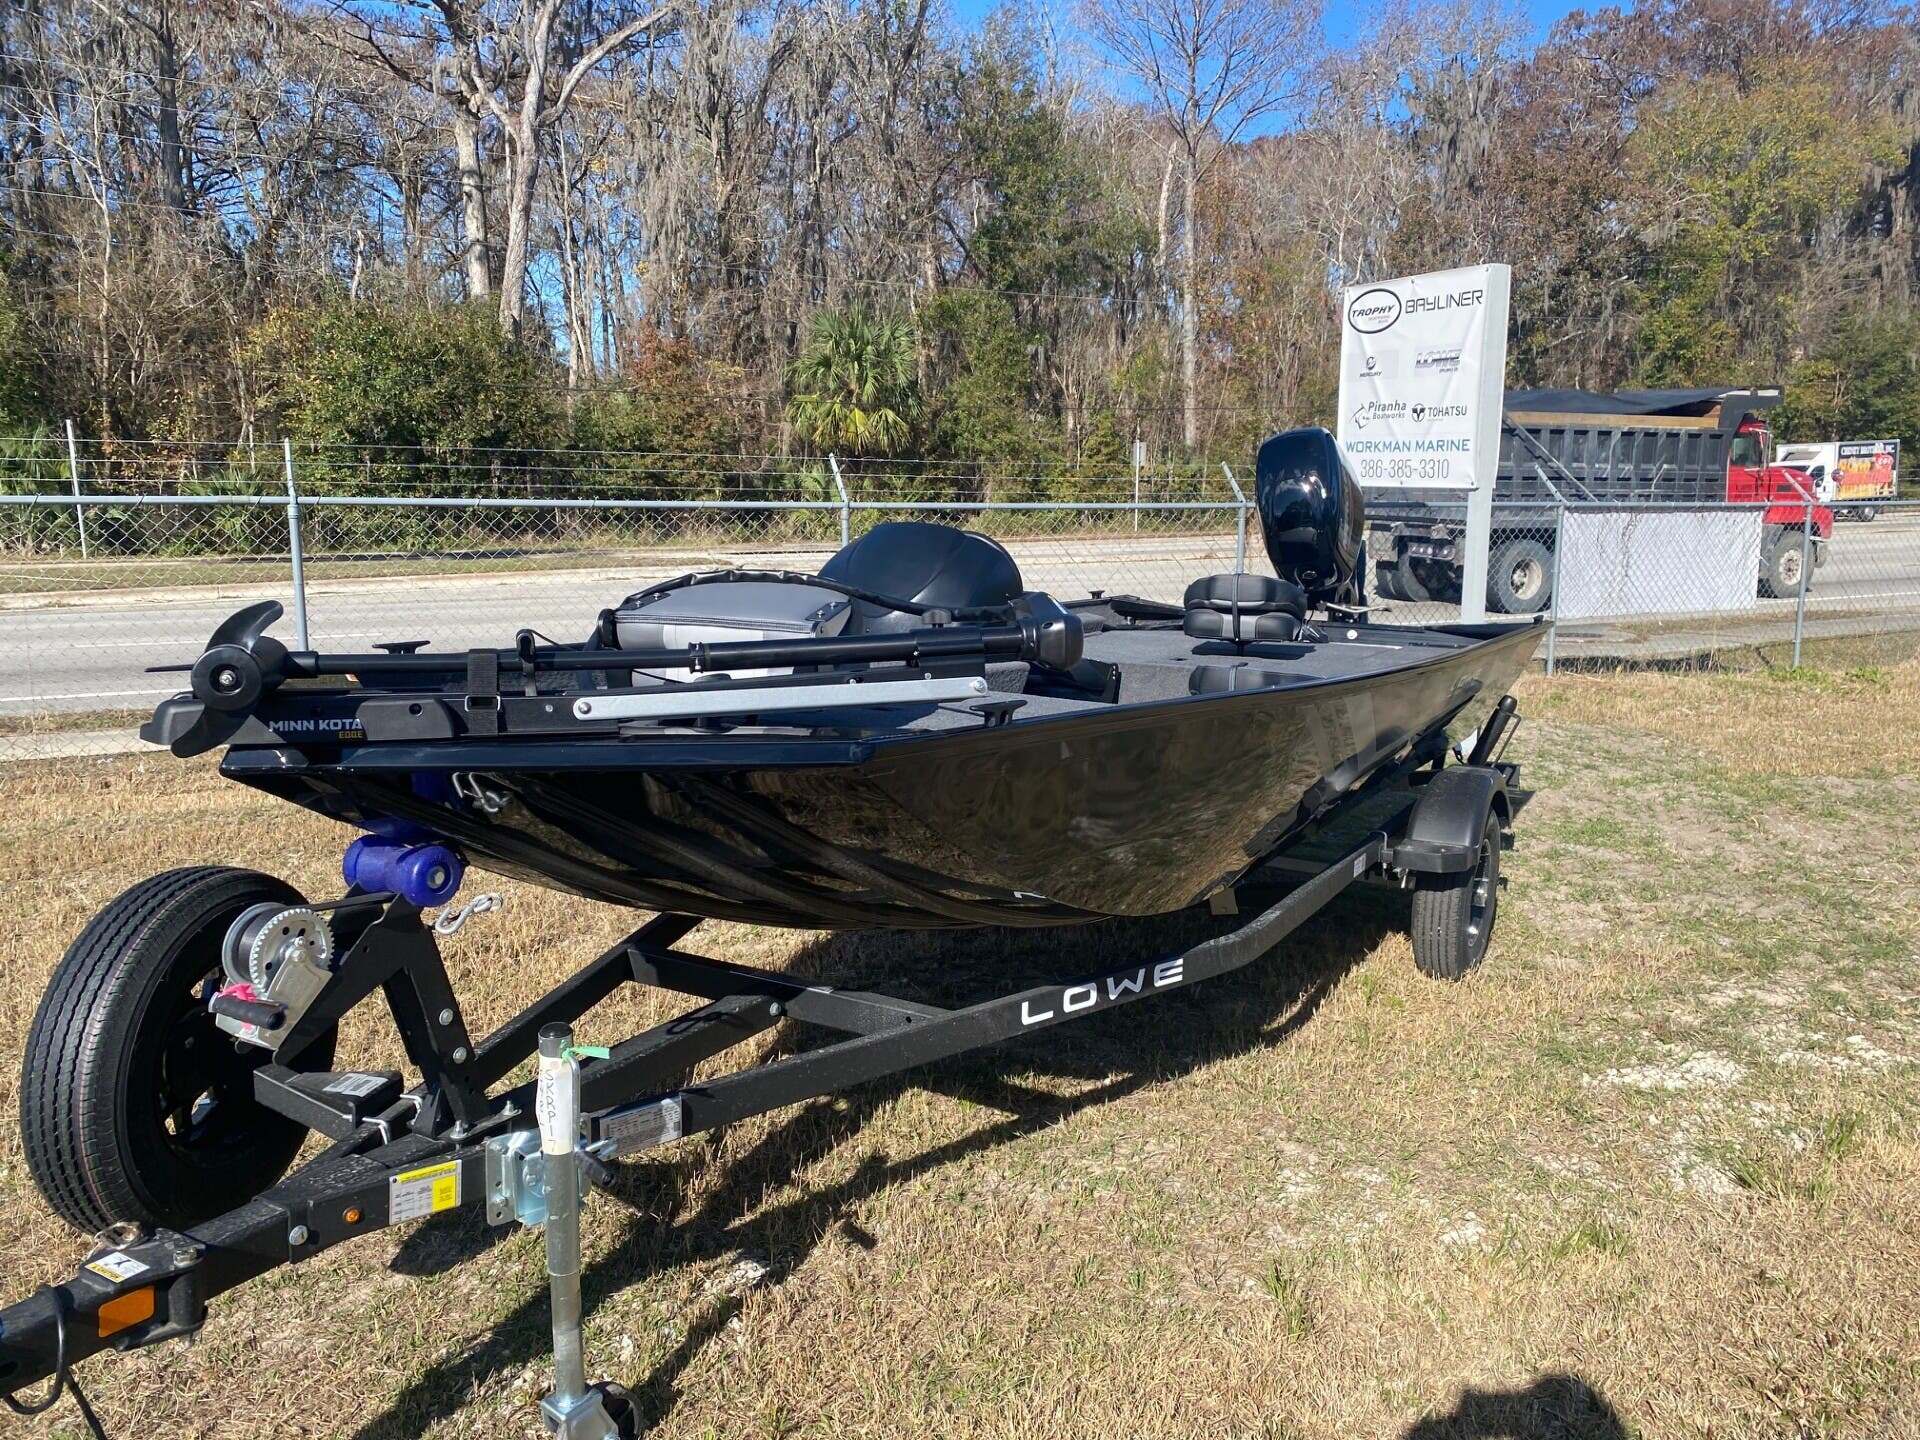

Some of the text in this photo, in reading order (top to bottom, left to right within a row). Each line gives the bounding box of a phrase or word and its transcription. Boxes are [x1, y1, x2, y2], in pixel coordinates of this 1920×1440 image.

[1405, 289, 1483, 314] BAYLINER
[1352, 304, 1395, 318] TROPHY
[1368, 400, 1407, 412] Piranha
[1428, 406, 1467, 417] TOHATSU
[1346, 439, 1470, 453] WORKMAN MARINE
[1360, 459, 1449, 478] 386-385-3310
[269, 719, 363, 731] MINN KOTA
[1021, 958, 1184, 1026] LOWE
